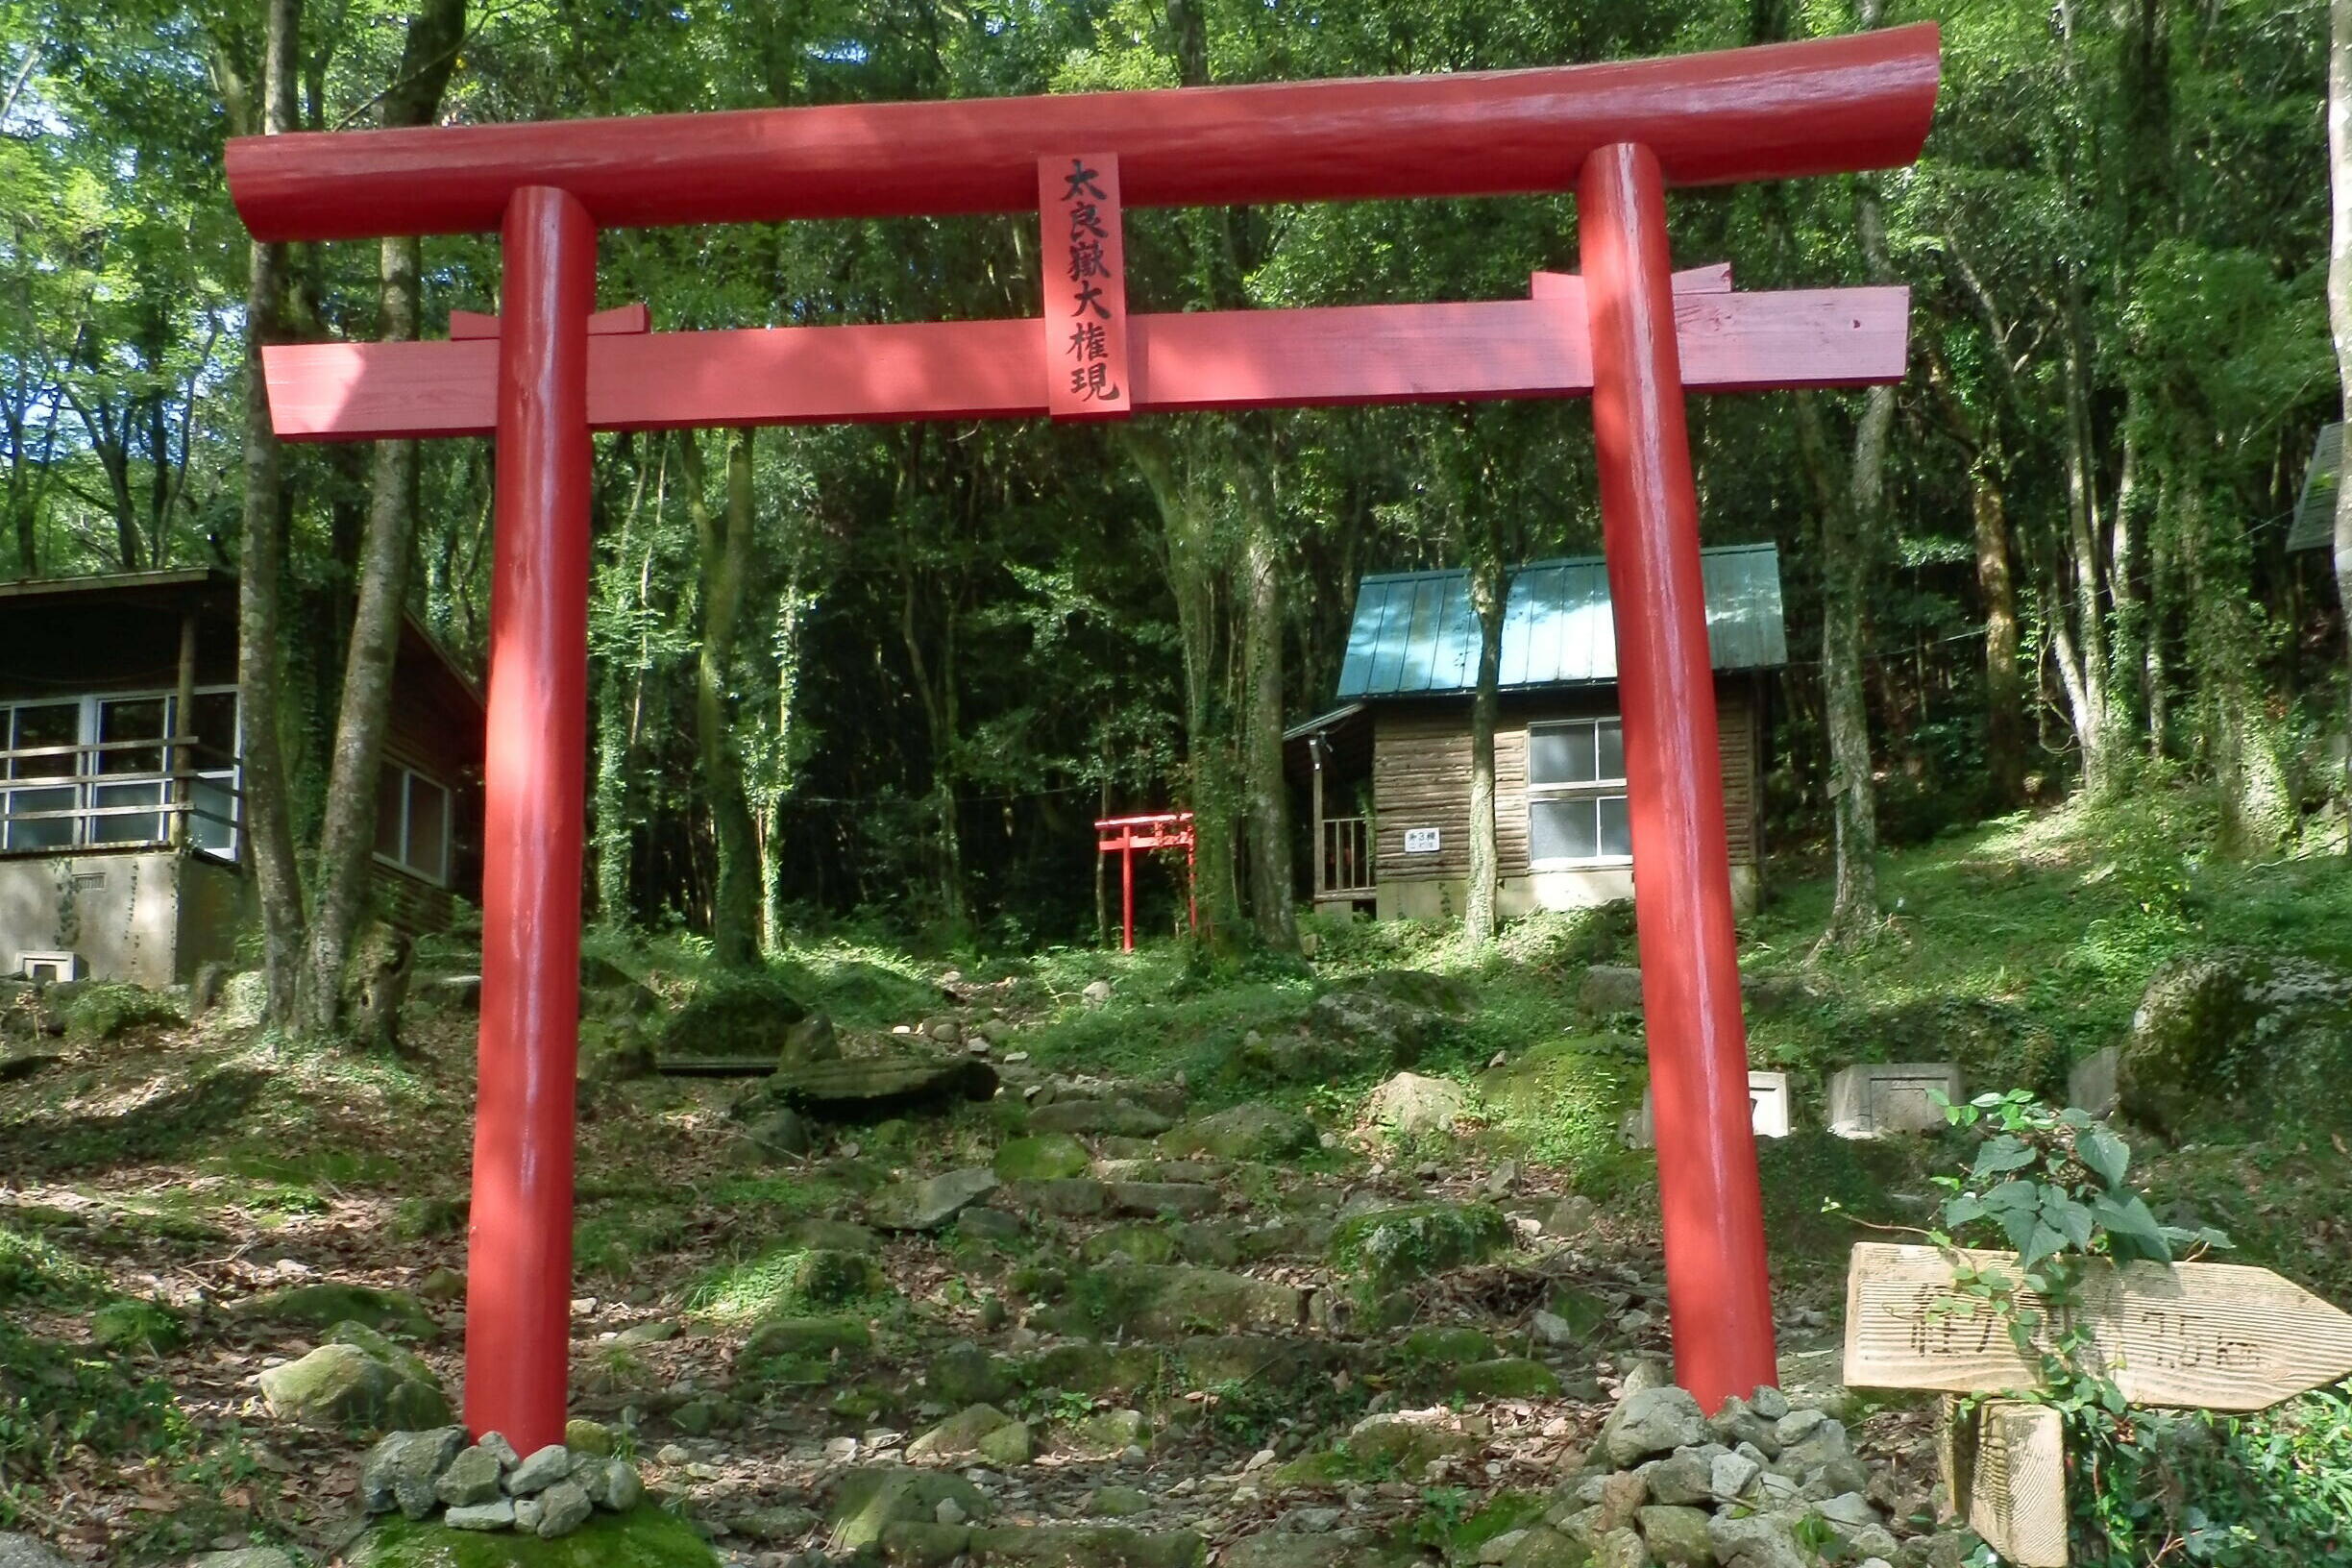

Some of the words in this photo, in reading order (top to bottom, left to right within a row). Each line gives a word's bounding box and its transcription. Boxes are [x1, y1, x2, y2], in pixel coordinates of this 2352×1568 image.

[1060, 159, 1120, 402] 太良嶽大権現
